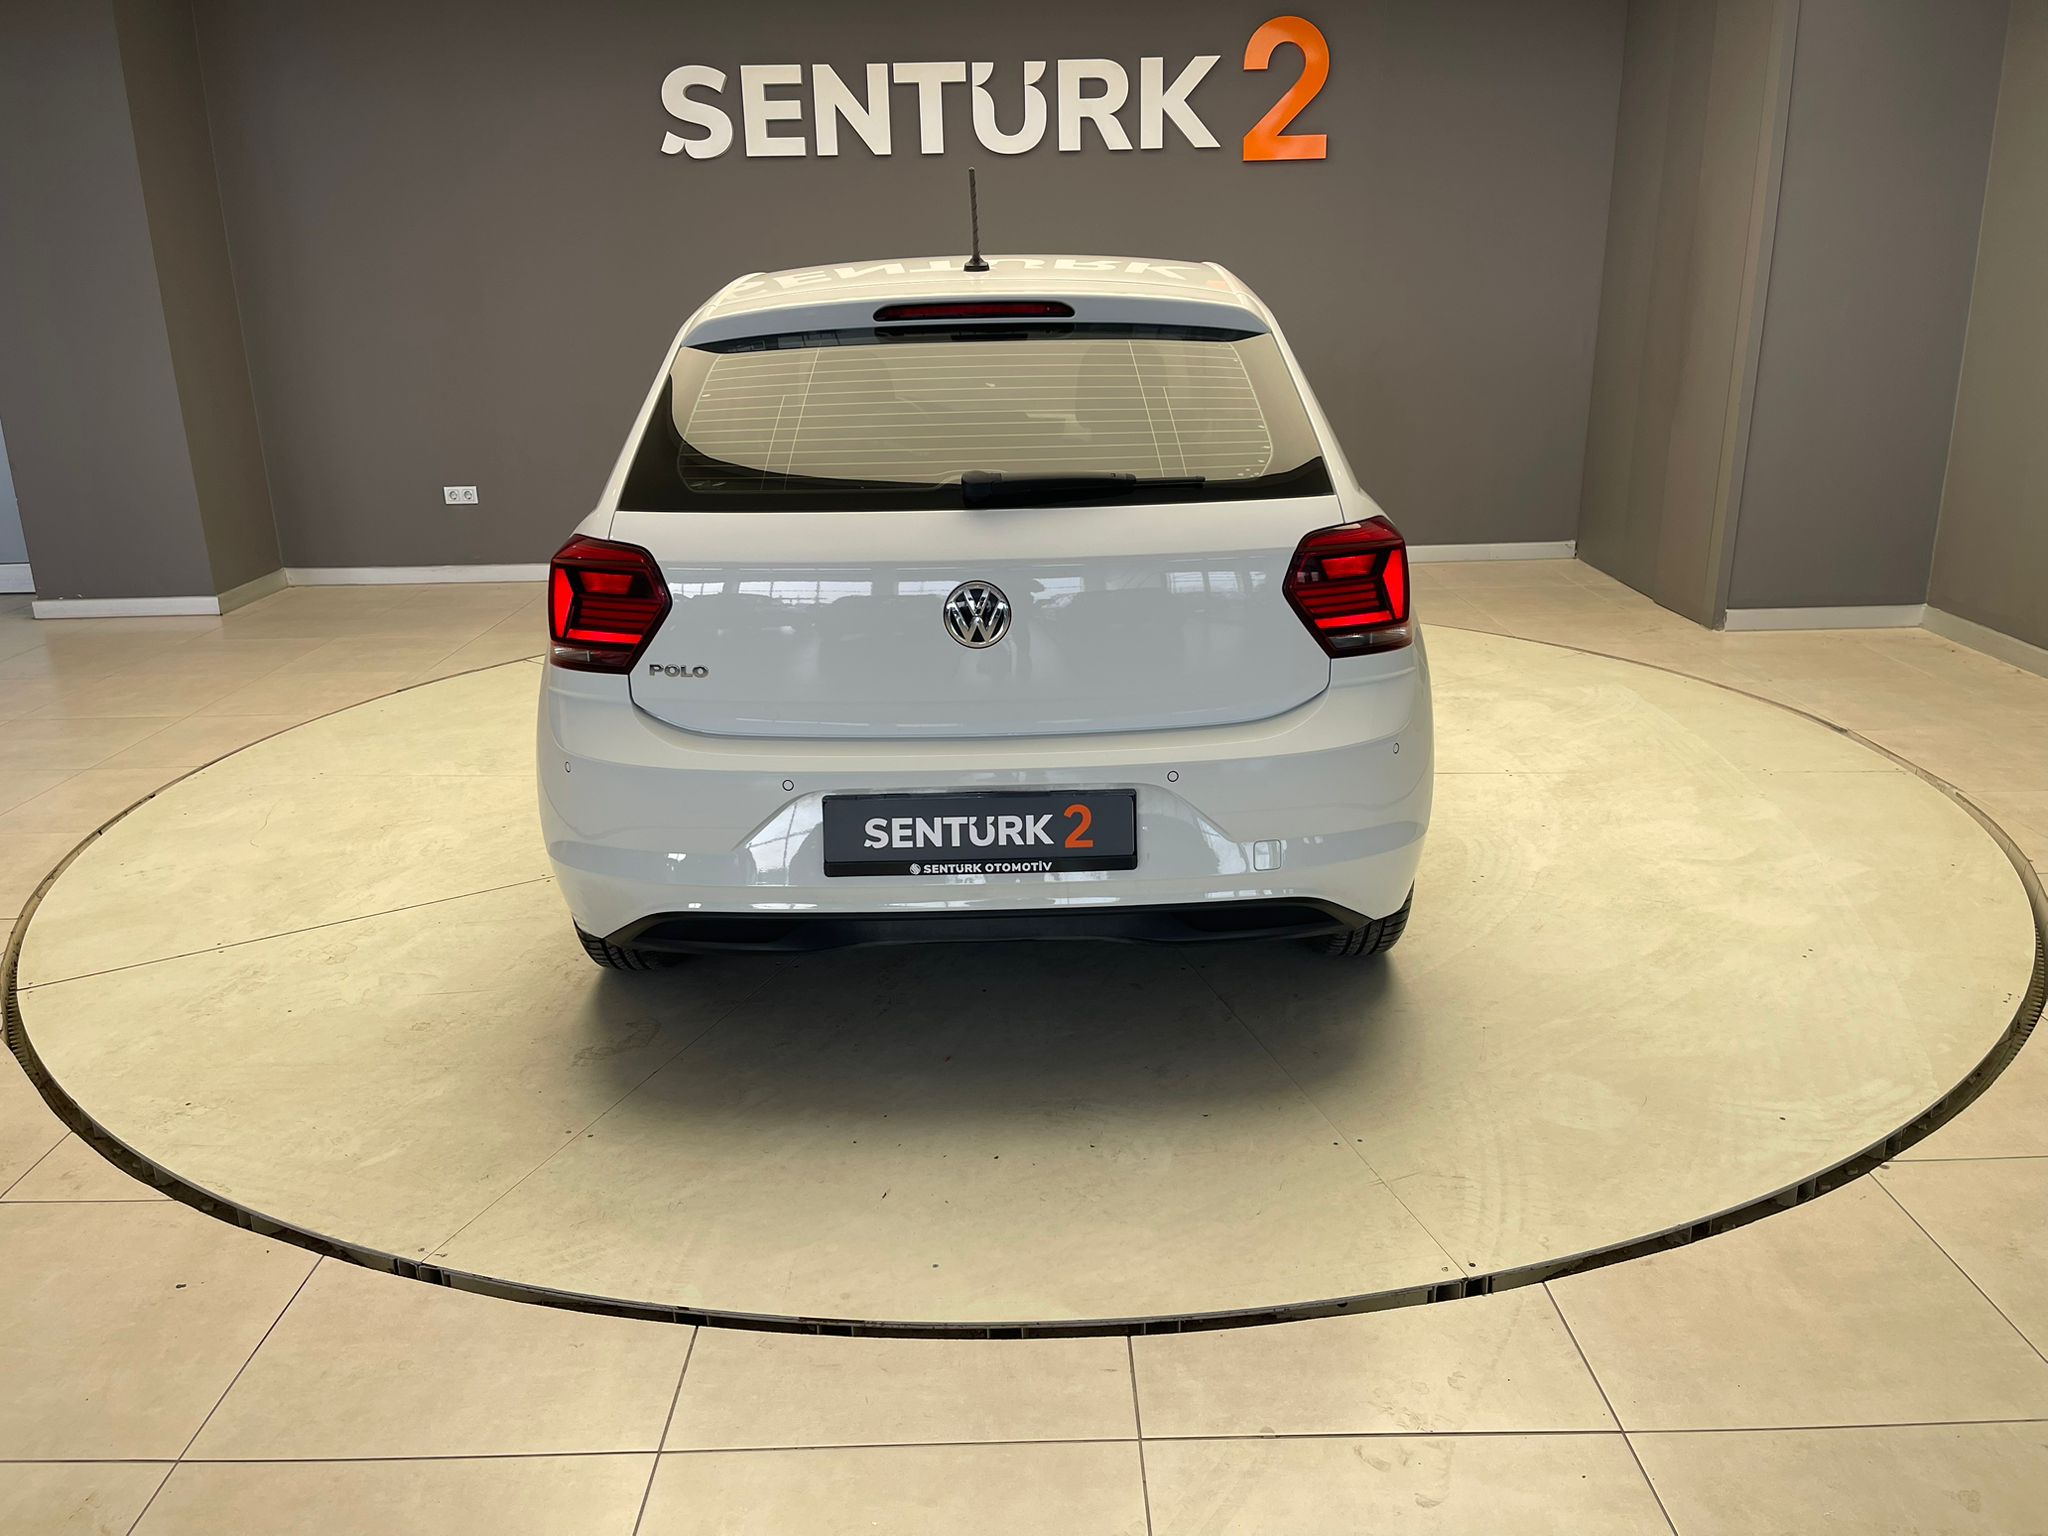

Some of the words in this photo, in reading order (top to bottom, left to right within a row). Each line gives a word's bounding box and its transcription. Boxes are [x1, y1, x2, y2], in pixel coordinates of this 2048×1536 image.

[1242, 15, 1331, 163] 2
[945, 582, 1010, 647] VW
[649, 664, 709, 678] POLO
[1063, 804, 1094, 848] 2
